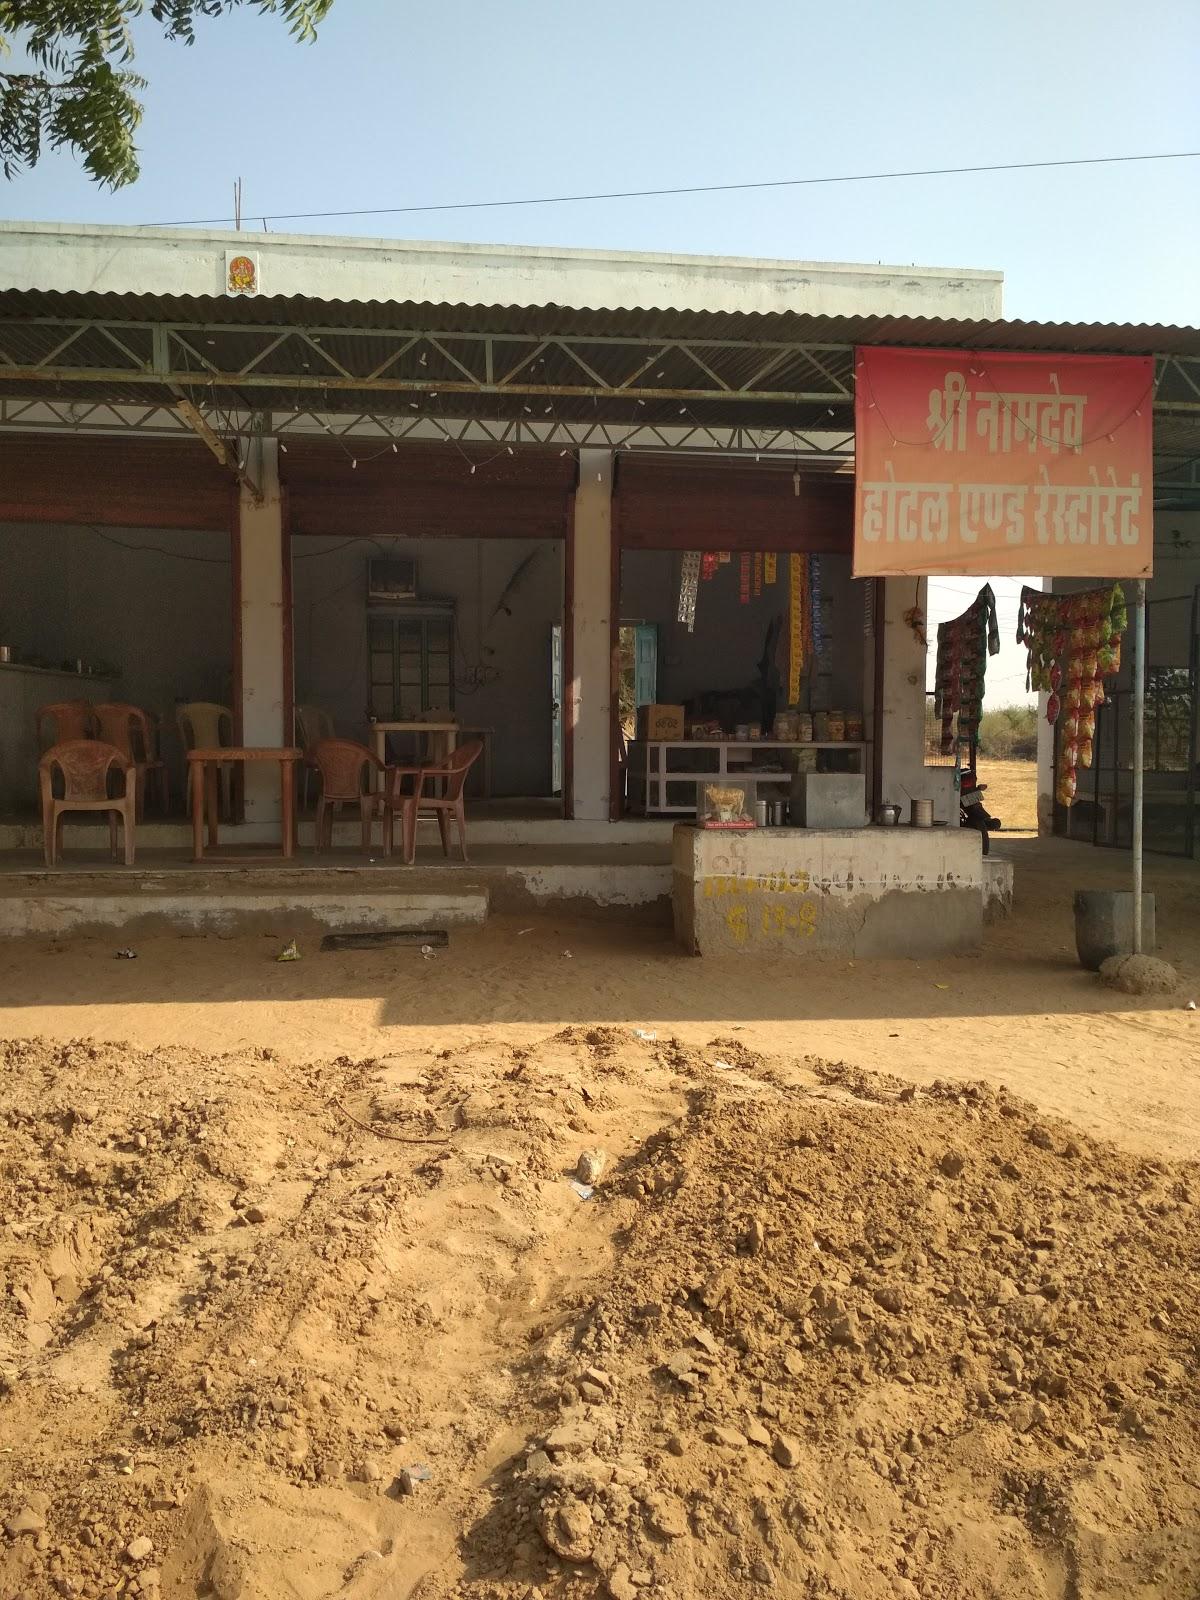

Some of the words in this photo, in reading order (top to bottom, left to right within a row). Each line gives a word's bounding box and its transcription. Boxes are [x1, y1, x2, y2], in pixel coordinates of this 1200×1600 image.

[927, 371, 971, 451] श्री
[975, 372, 1088, 454] नामदेव
[862, 460, 954, 544] होटल
[958, 484, 1029, 545] एण्ड
